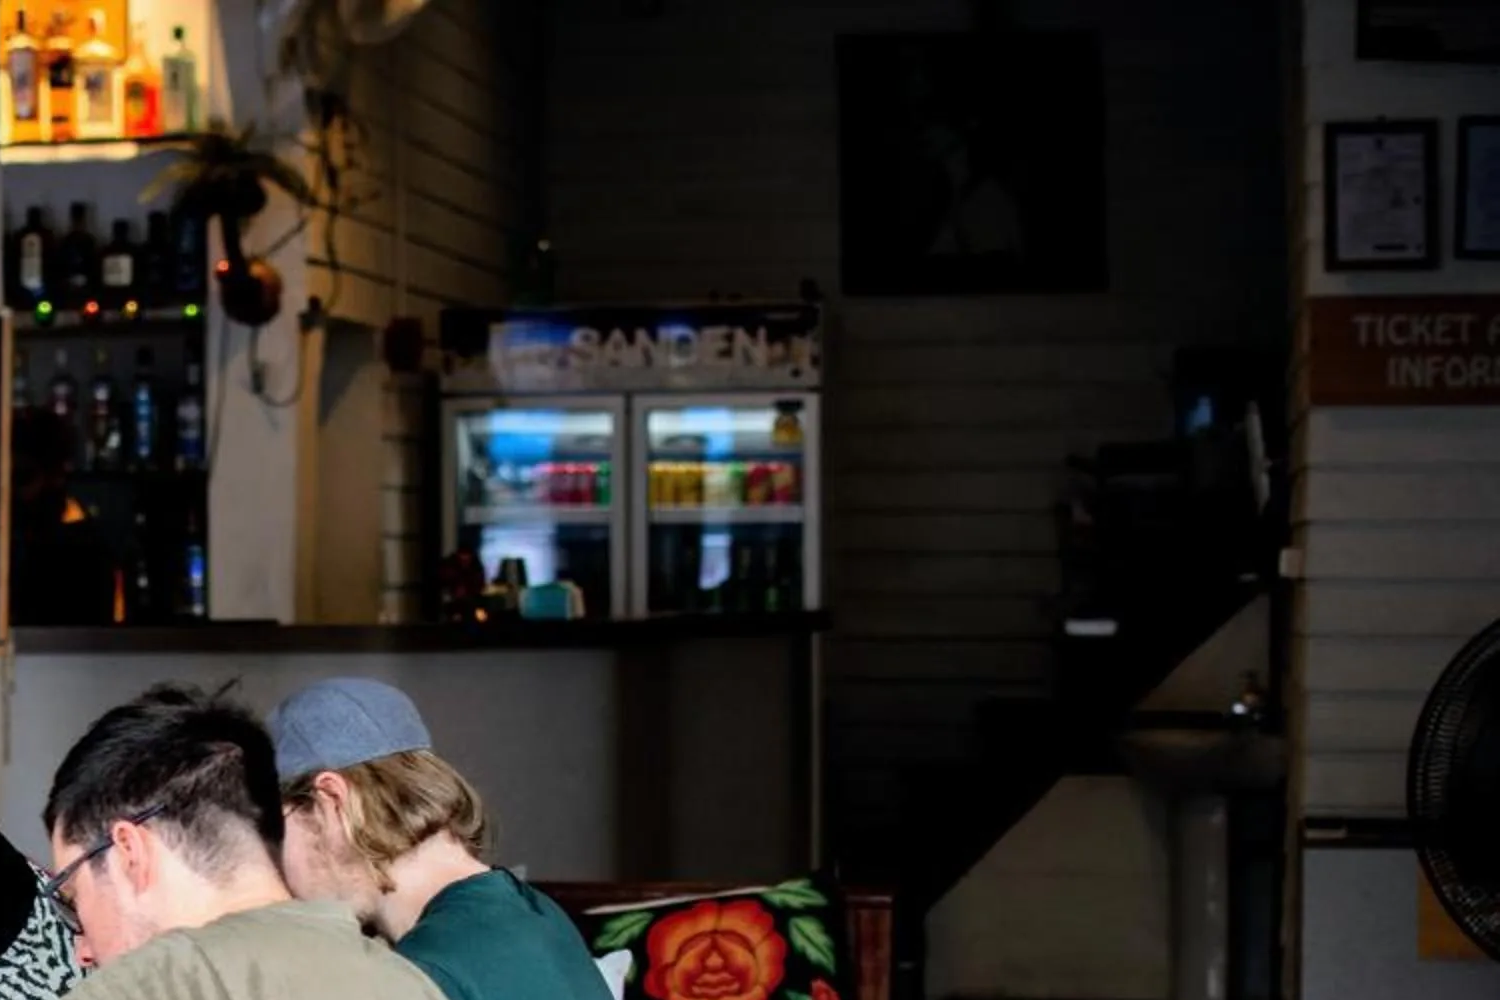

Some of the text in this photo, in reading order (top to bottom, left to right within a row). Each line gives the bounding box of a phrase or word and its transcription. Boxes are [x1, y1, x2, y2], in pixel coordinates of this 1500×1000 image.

[568, 324, 769, 368] SANDEN
[1350, 312, 1479, 348] TICKET
[1384, 354, 1500, 389] INFOR
